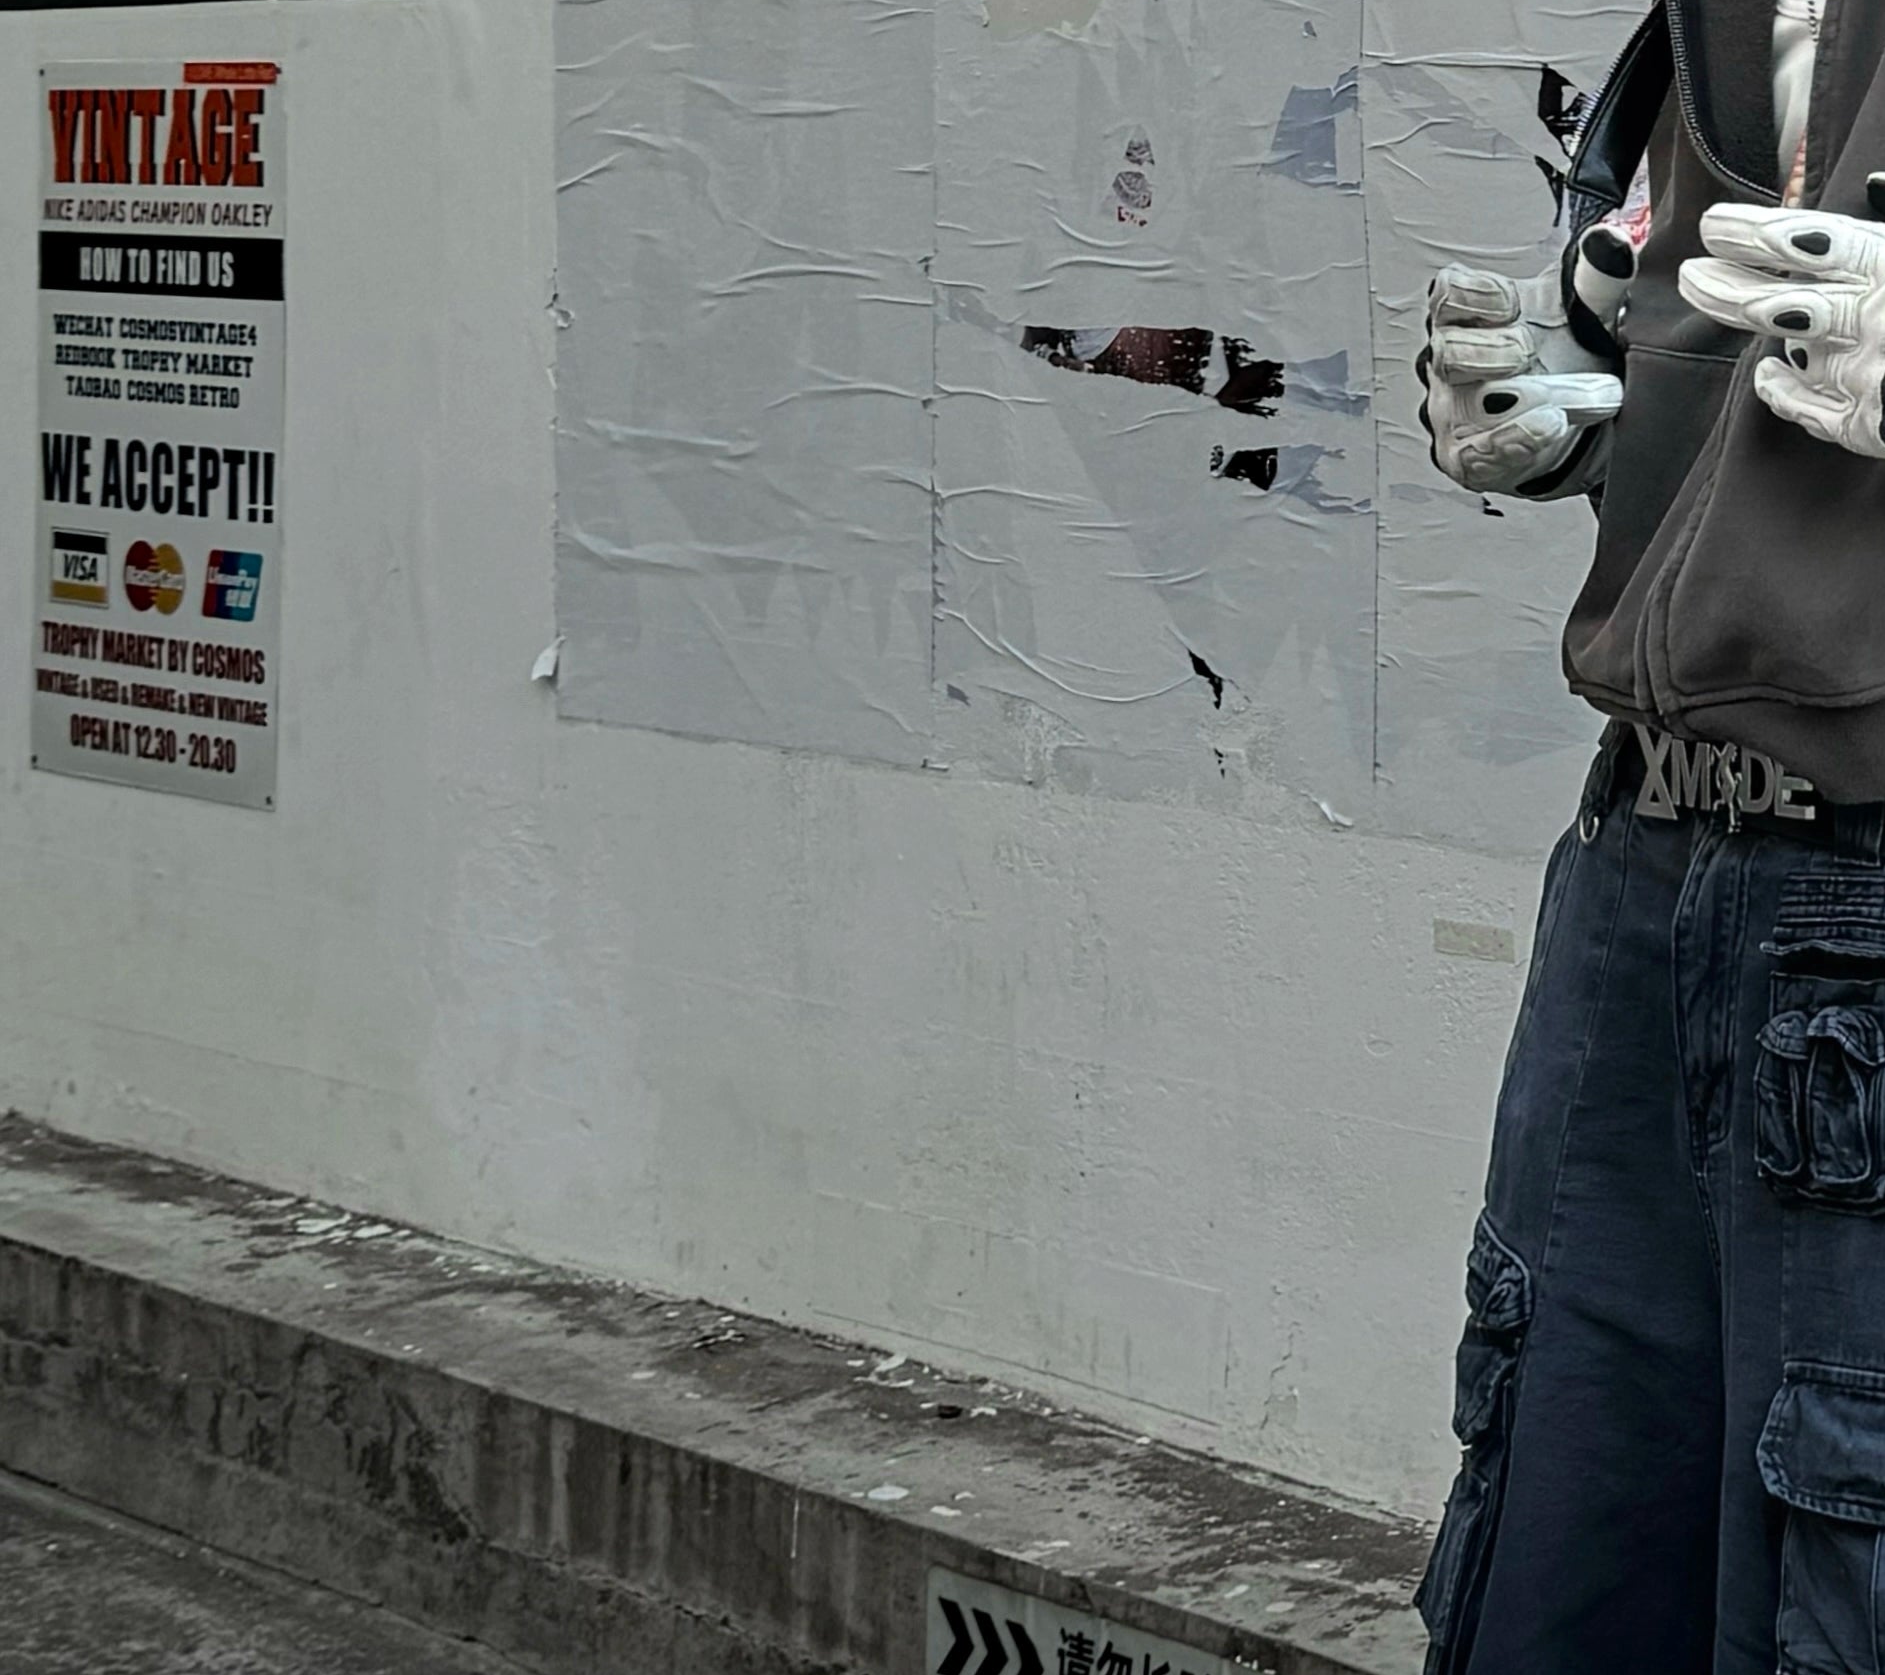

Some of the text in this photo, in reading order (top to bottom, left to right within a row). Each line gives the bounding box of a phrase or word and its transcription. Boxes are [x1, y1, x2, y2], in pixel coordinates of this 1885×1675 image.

[48, 88, 265, 187] VINTAGE
[44, 198, 273, 227] NIKE ADIDAS CHAMPION OAKLEY
[79, 246, 235, 287] HOW TO FIND US
[53, 313, 114, 338] WECHAT
[55, 344, 254, 378] REDBOOK TROPHY MARKET
[66, 375, 240, 409] TAOBAO COSMOS RETRO
[41, 432, 275, 524] WE ACCEPT!!
[63, 553, 98, 582] VISA
[42, 620, 266, 685] TROPHY MARKET BY COSMOS
[70, 713, 109, 751] OPEN
[112, 721, 131, 756] AT
[133, 724, 176, 764] 12.30
[188, 732, 237, 773] 20.30
